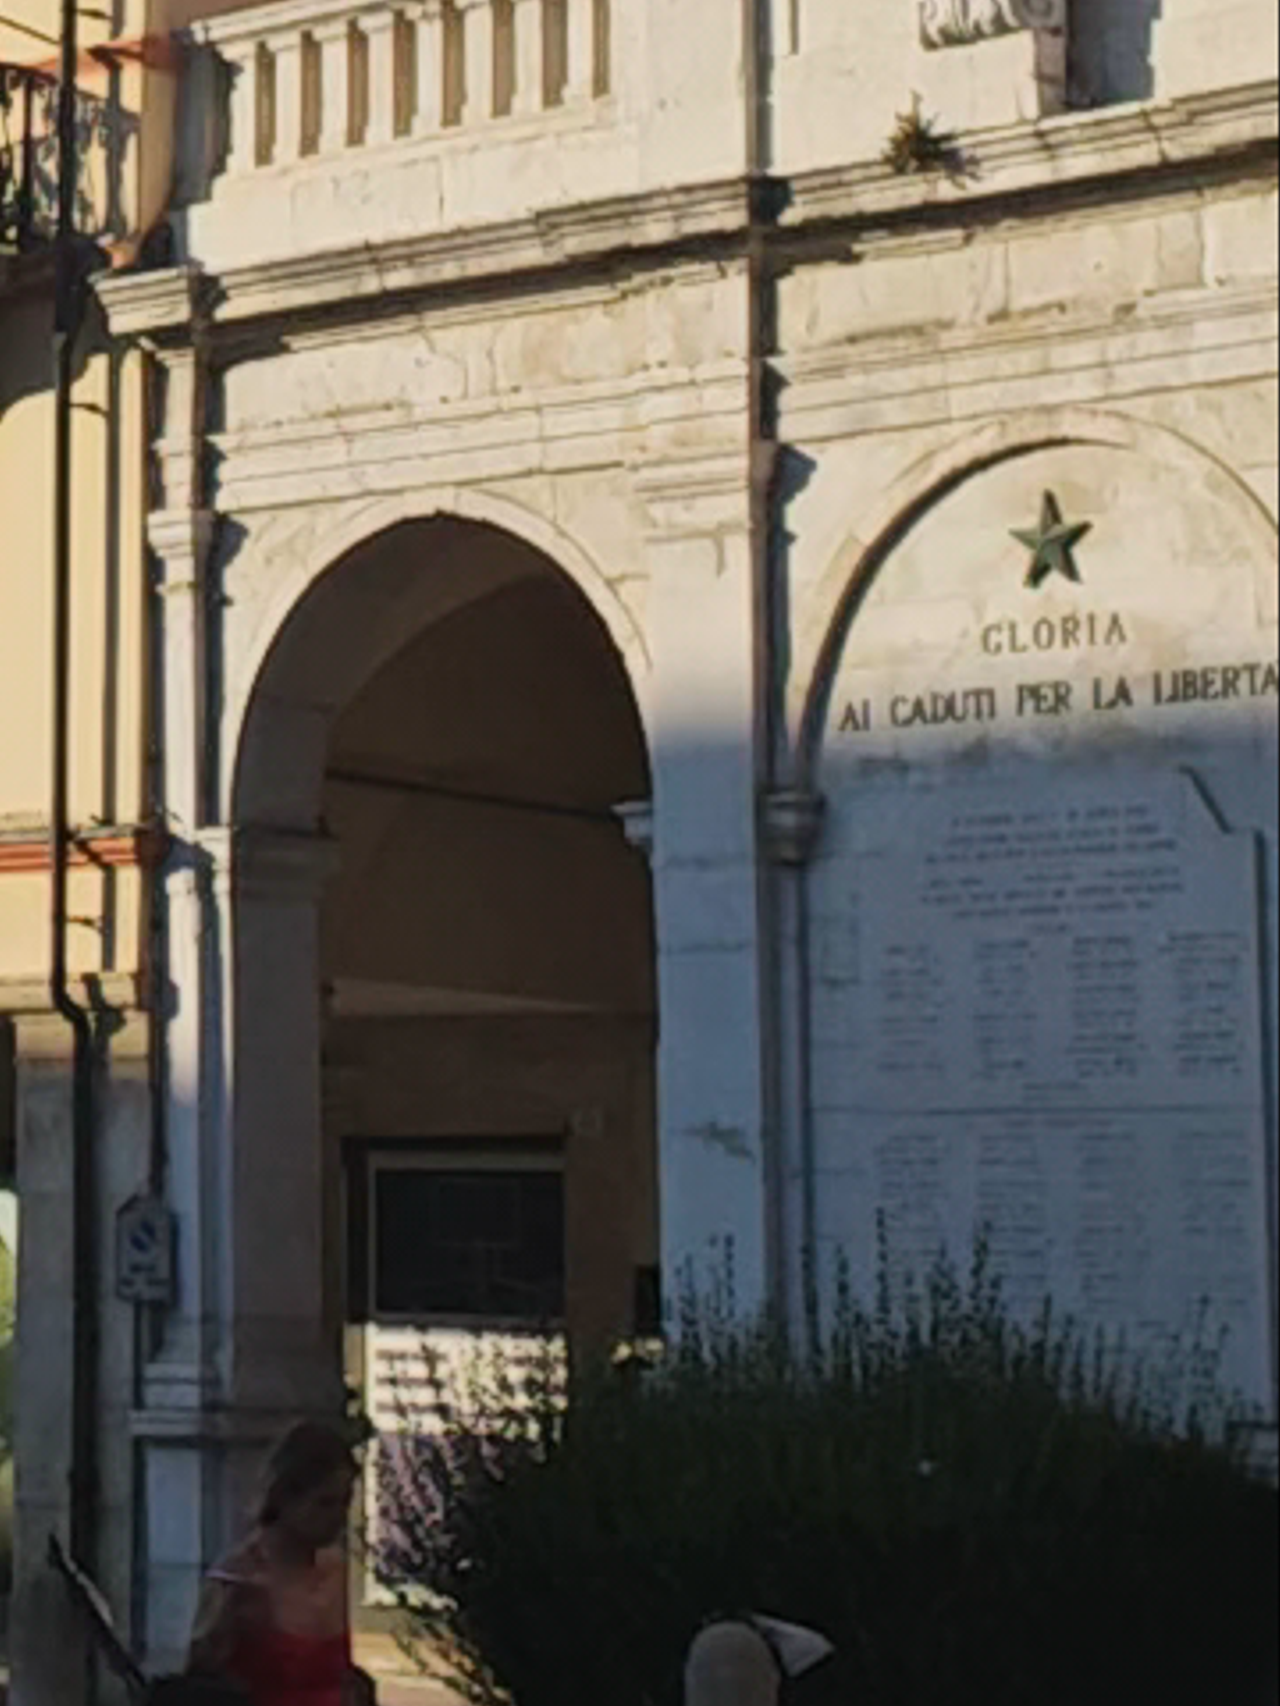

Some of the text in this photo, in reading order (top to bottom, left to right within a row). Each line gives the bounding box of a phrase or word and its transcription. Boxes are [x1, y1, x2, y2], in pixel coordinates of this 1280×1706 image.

[981, 612, 1128, 656] GLORIA
[839, 699, 871, 732] AI
[889, 686, 996, 729] CADUTI
[1015, 680, 1072, 719] PER
[1092, 676, 1134, 710] LA
